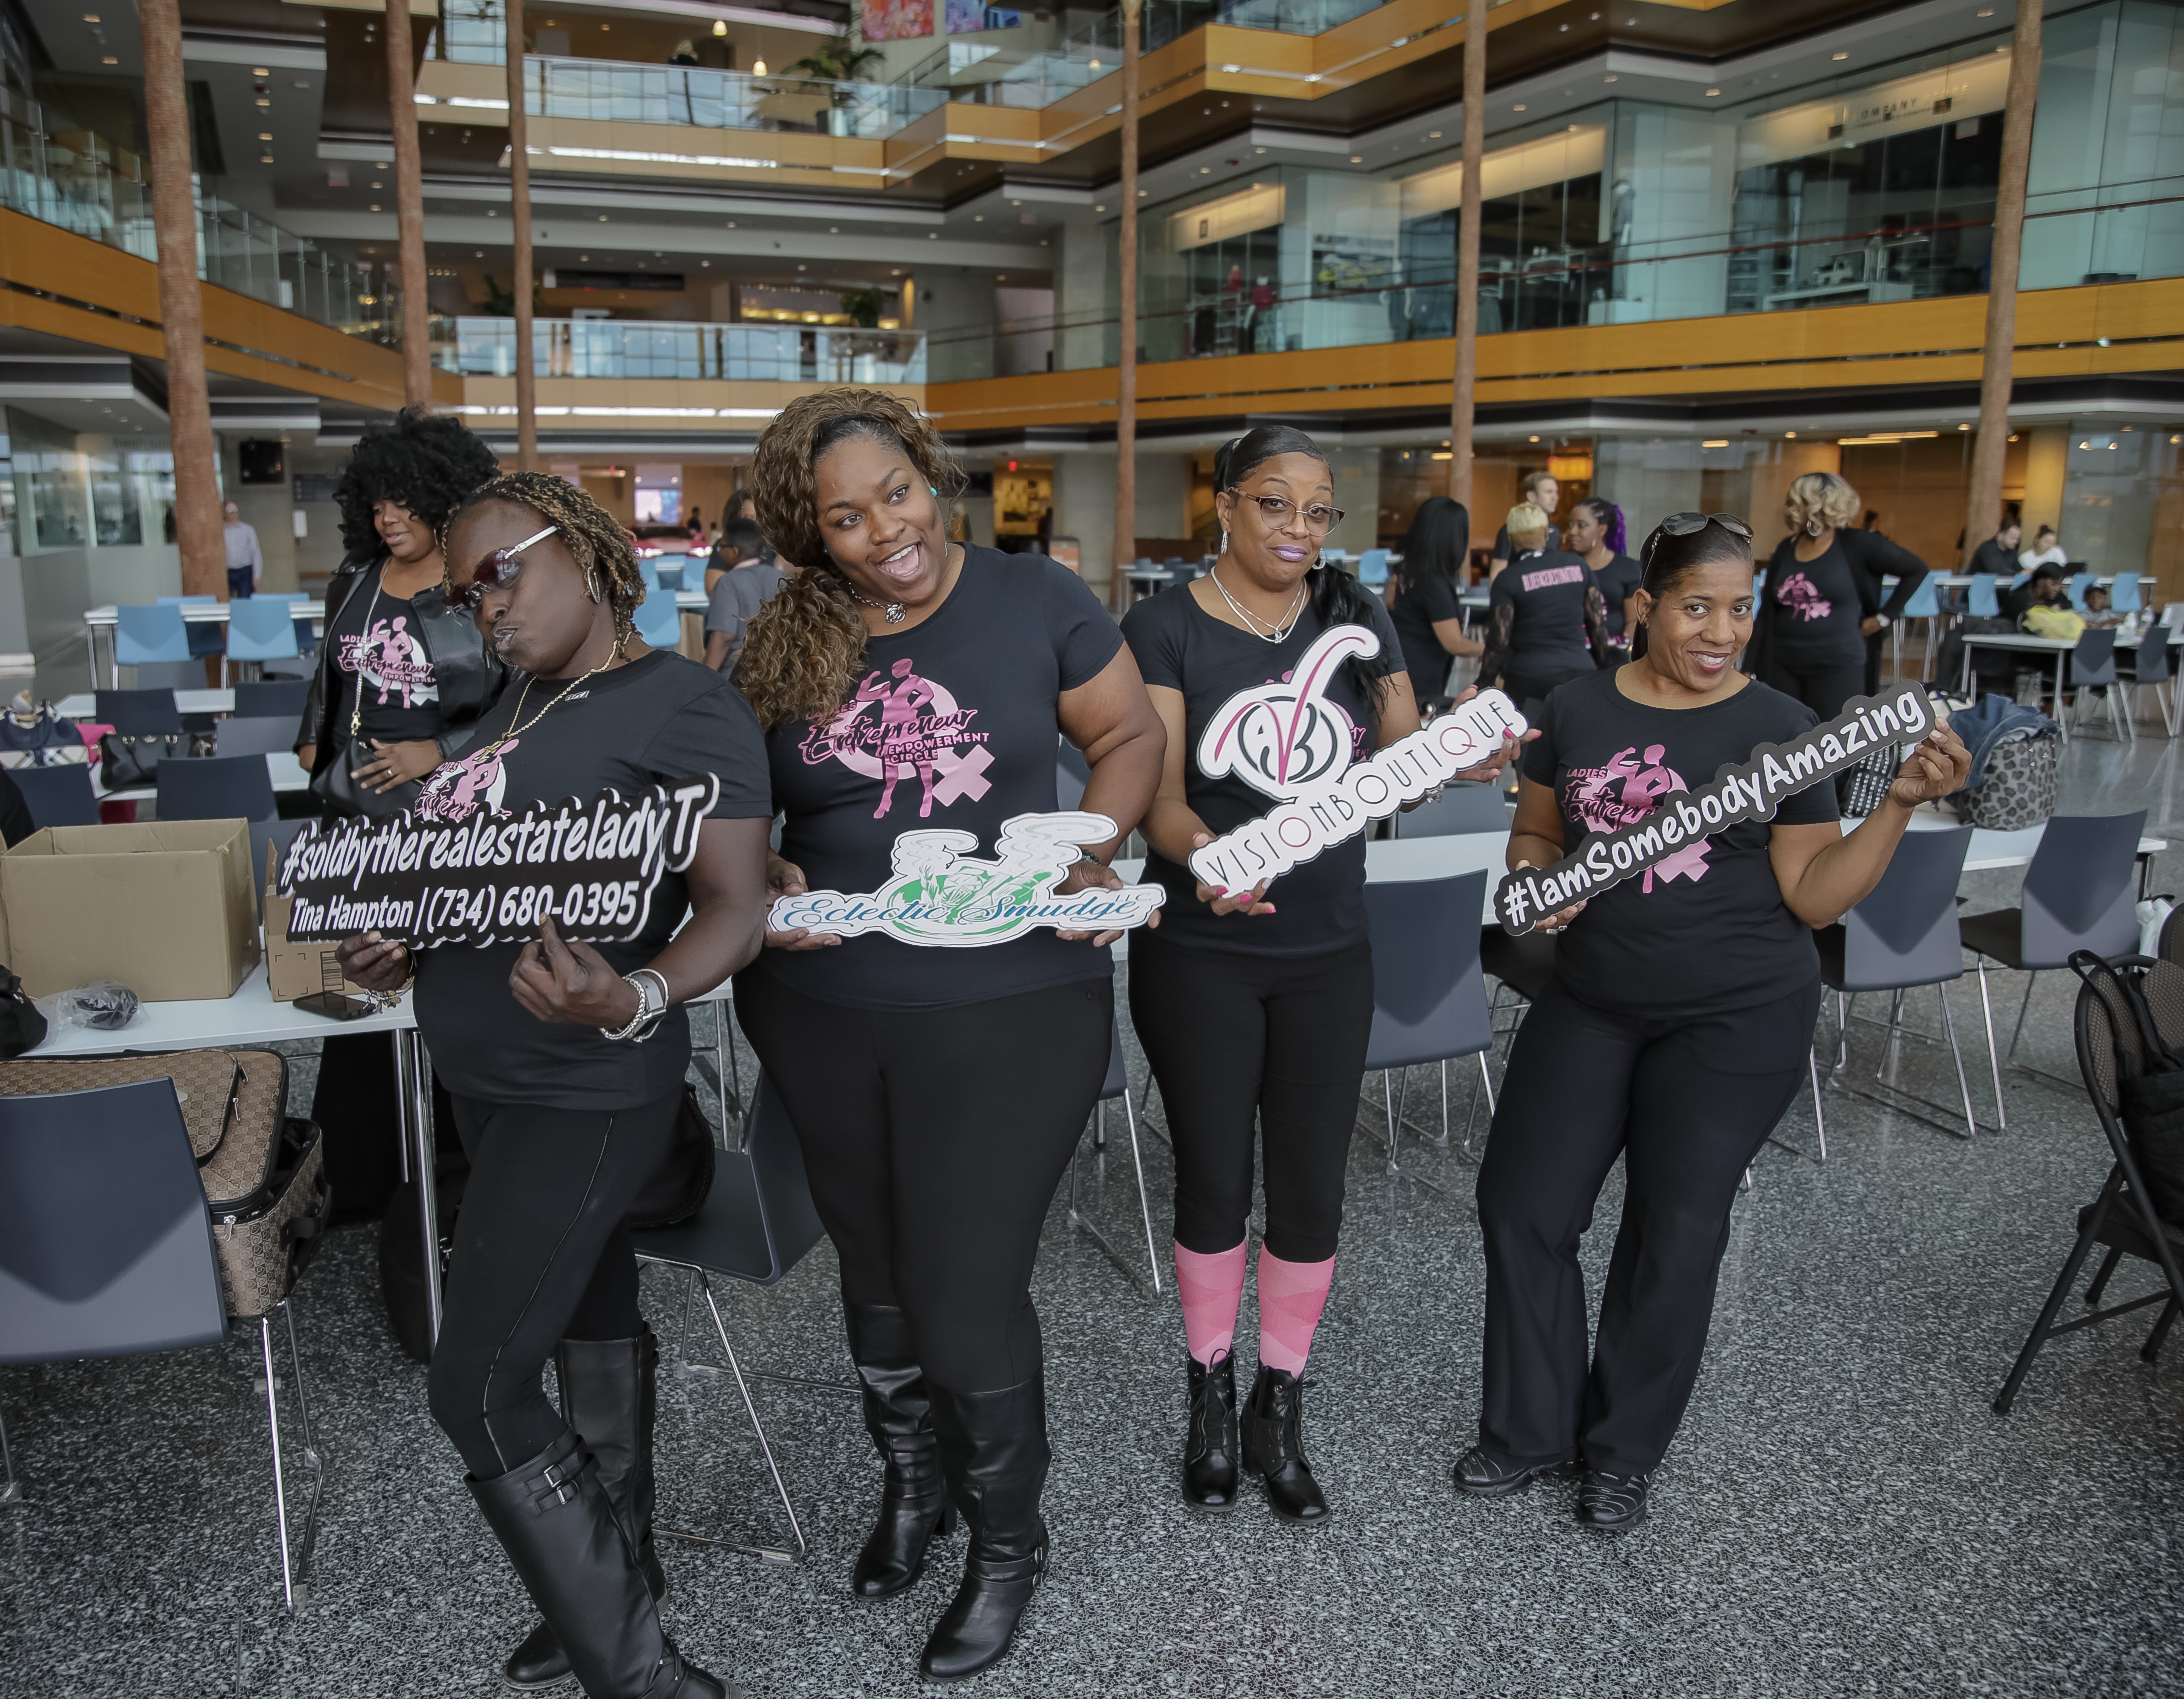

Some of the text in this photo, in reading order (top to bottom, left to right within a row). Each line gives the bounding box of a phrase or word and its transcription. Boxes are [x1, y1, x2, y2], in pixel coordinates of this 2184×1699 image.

[385, 673, 436, 683] EMPOWERMEN
[799, 709, 978, 764] Entrepreneur
[889, 733, 990, 755] EMPOWERMENT
[890, 749, 938, 763] CIRCLE
[1566, 768, 1607, 778] LADIES
[292, 897, 324, 933] Tina
[325, 894, 414, 933] Hampton
[427, 885, 495, 933] (734)
[499, 883, 639, 926] 680-0395
[783, 899, 949, 928] Eclectic
[959, 891, 1140, 922] Smudge
